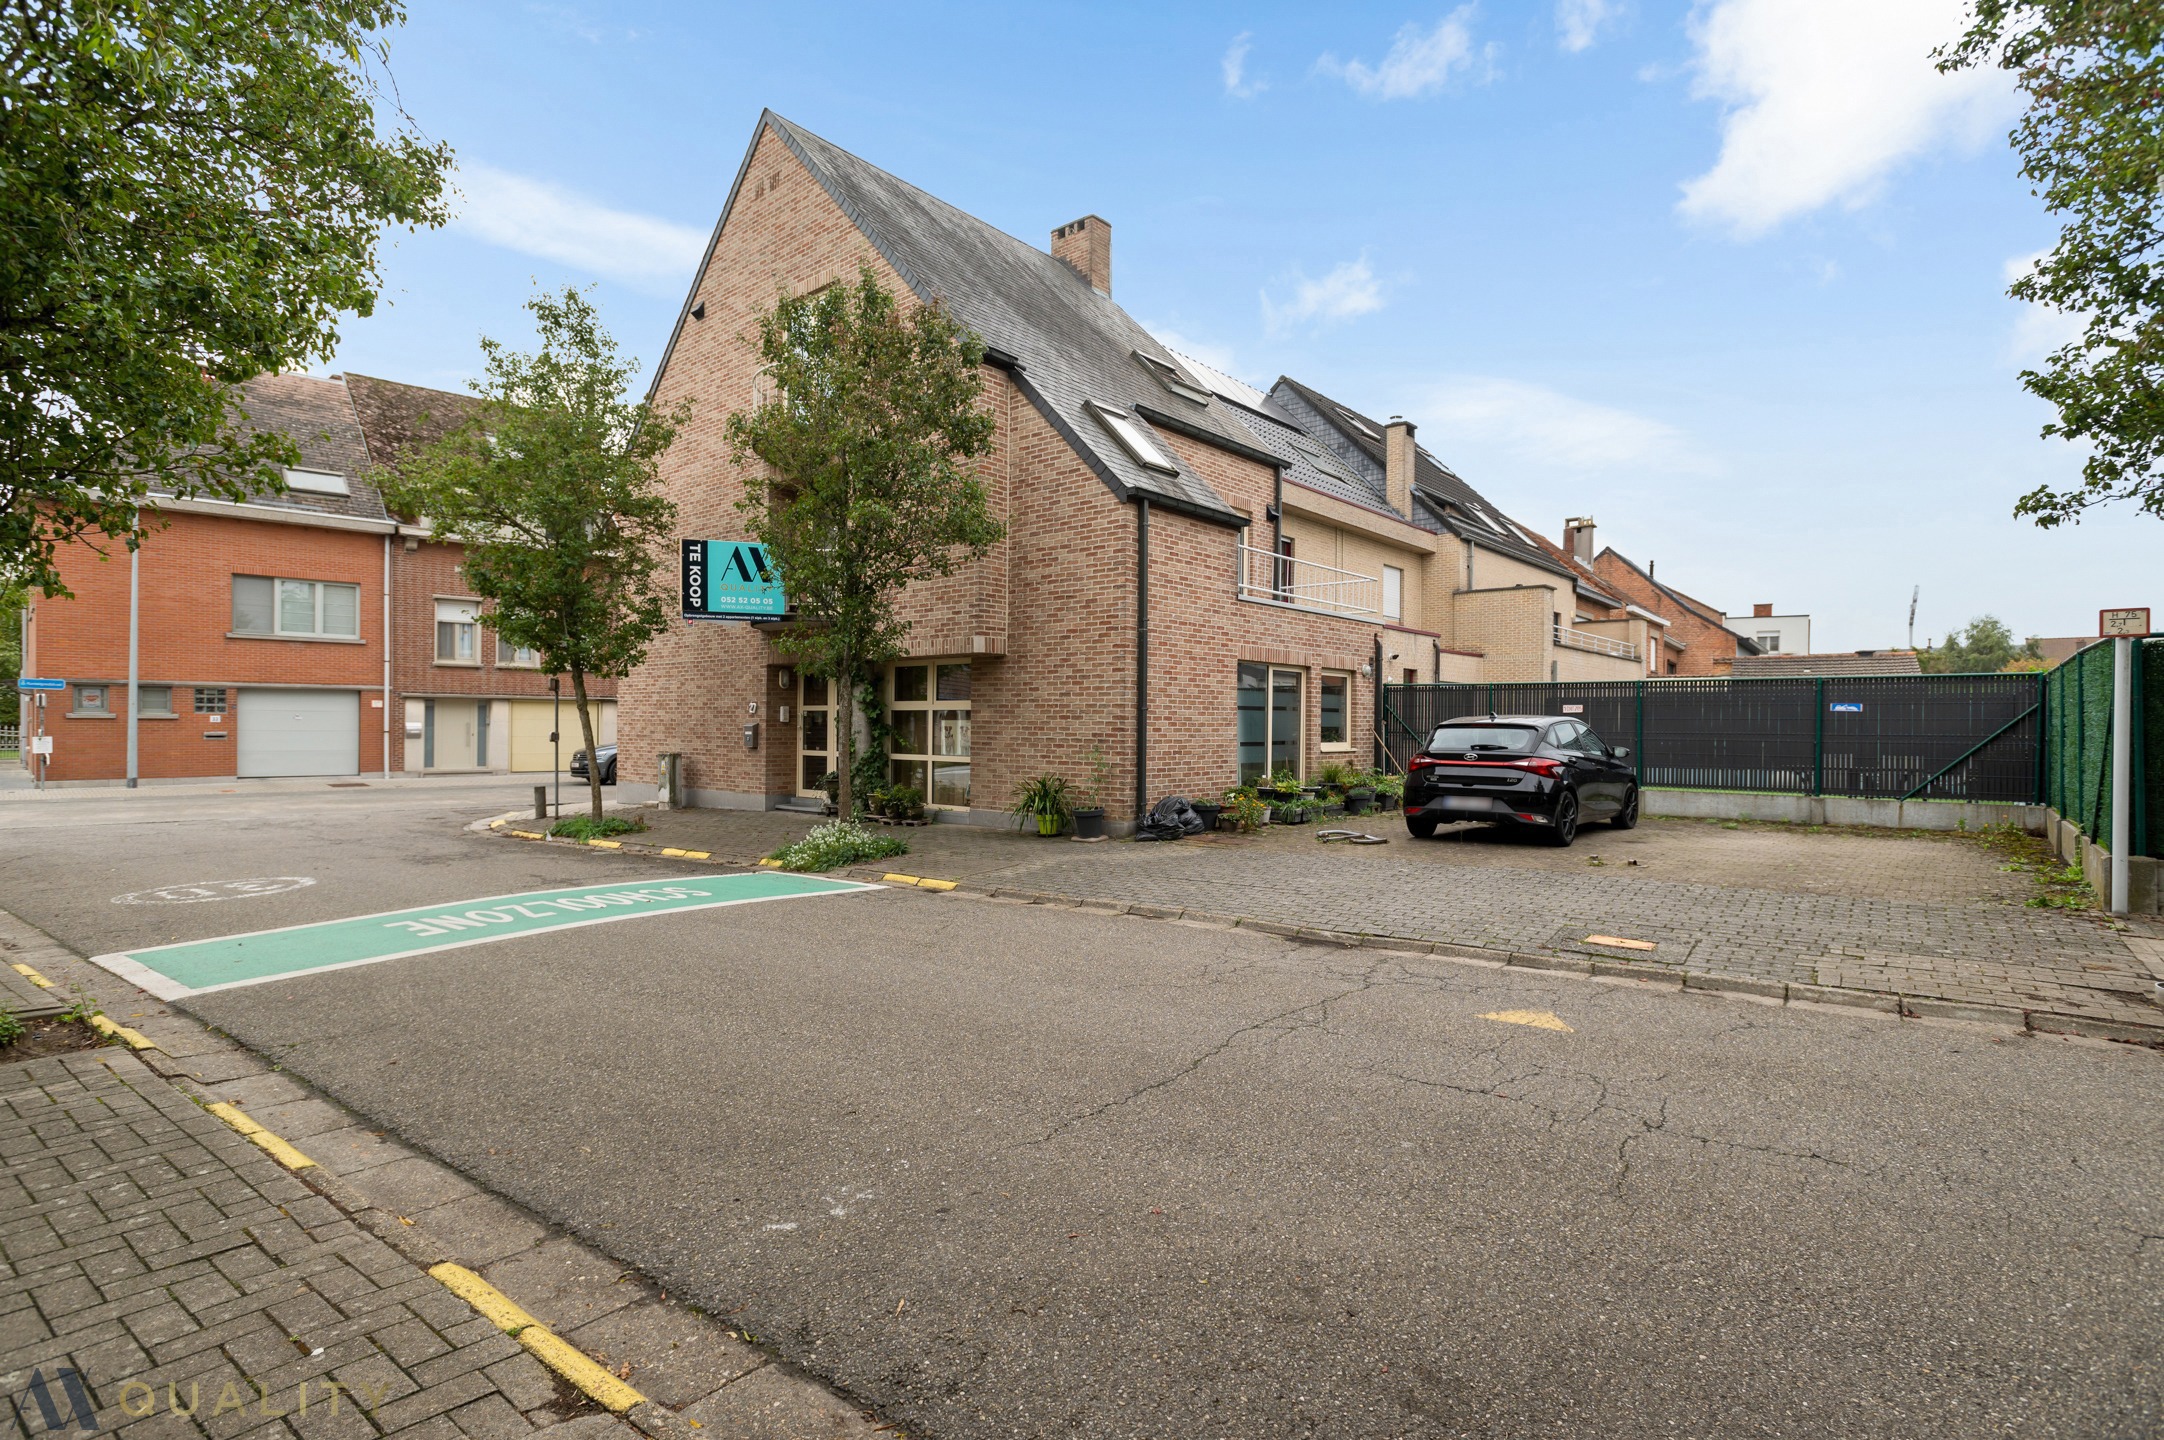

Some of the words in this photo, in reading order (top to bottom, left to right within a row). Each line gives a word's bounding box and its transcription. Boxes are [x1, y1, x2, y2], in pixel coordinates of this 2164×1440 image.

[689, 543, 702, 562] TE
[689, 566, 702, 608] KOOP
[720, 596, 736, 604] 052
[750, 597, 761, 605] 05
[2125, 610, 2137, 618] 75
